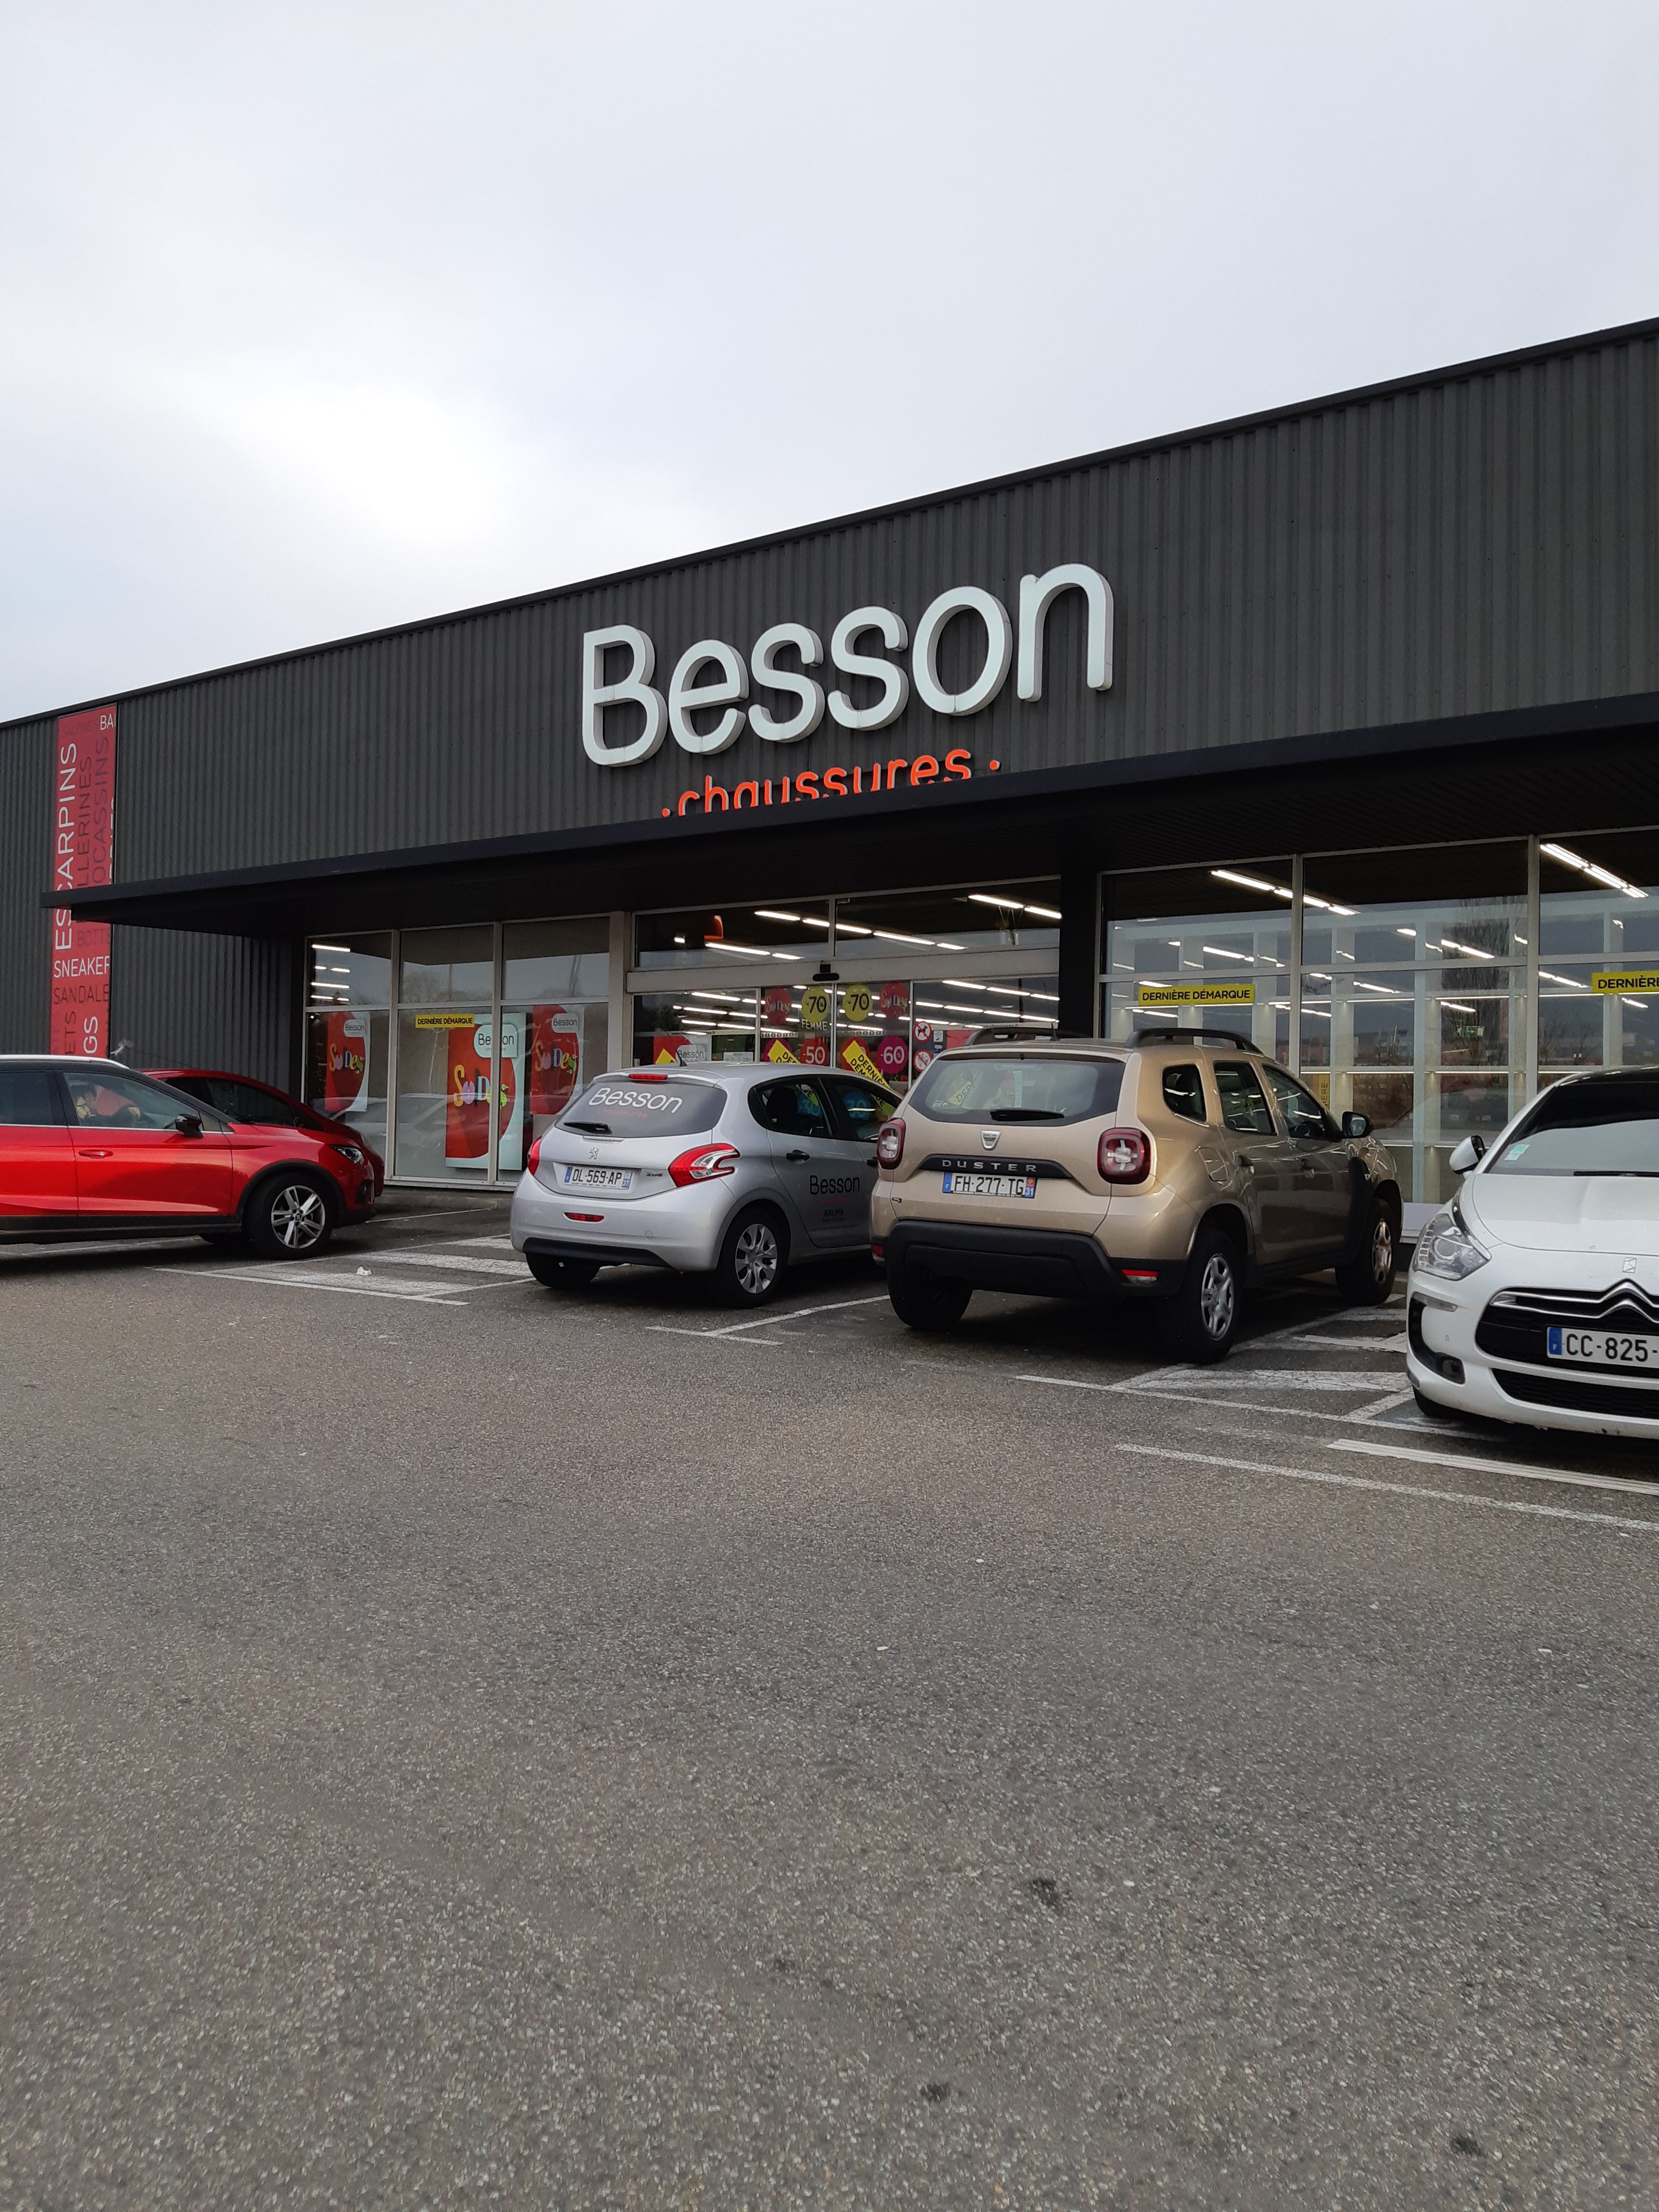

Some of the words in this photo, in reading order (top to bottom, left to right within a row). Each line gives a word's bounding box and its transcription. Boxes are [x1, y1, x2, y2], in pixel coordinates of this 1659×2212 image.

[582, 563, 1114, 767] Besson
[100, 712, 116, 731] BA
[678, 749, 972, 816] chaussures
[1142, 989, 1190, 1001] DERNIÈRE
[1192, 988, 1250, 1000] DÉMARQUE
[417, 1016, 443, 1025] DERNIÈRE
[444, 1016, 473, 1024] DÉMARQUE
[553, 1018, 577, 1026] Besson
[802, 1019, 827, 1031] FEMME
[478, 1034, 515, 1046] Beon
[677, 1050, 705, 1059] Besson
[589, 1087, 683, 1114] Besson
[942, 1159, 1037, 1173] DUSTER
[572, 1168, 623, 1185] DL-569-AP
[809, 1175, 860, 1195] Besson
[954, 1175, 1024, 1195] FH-277-TG
